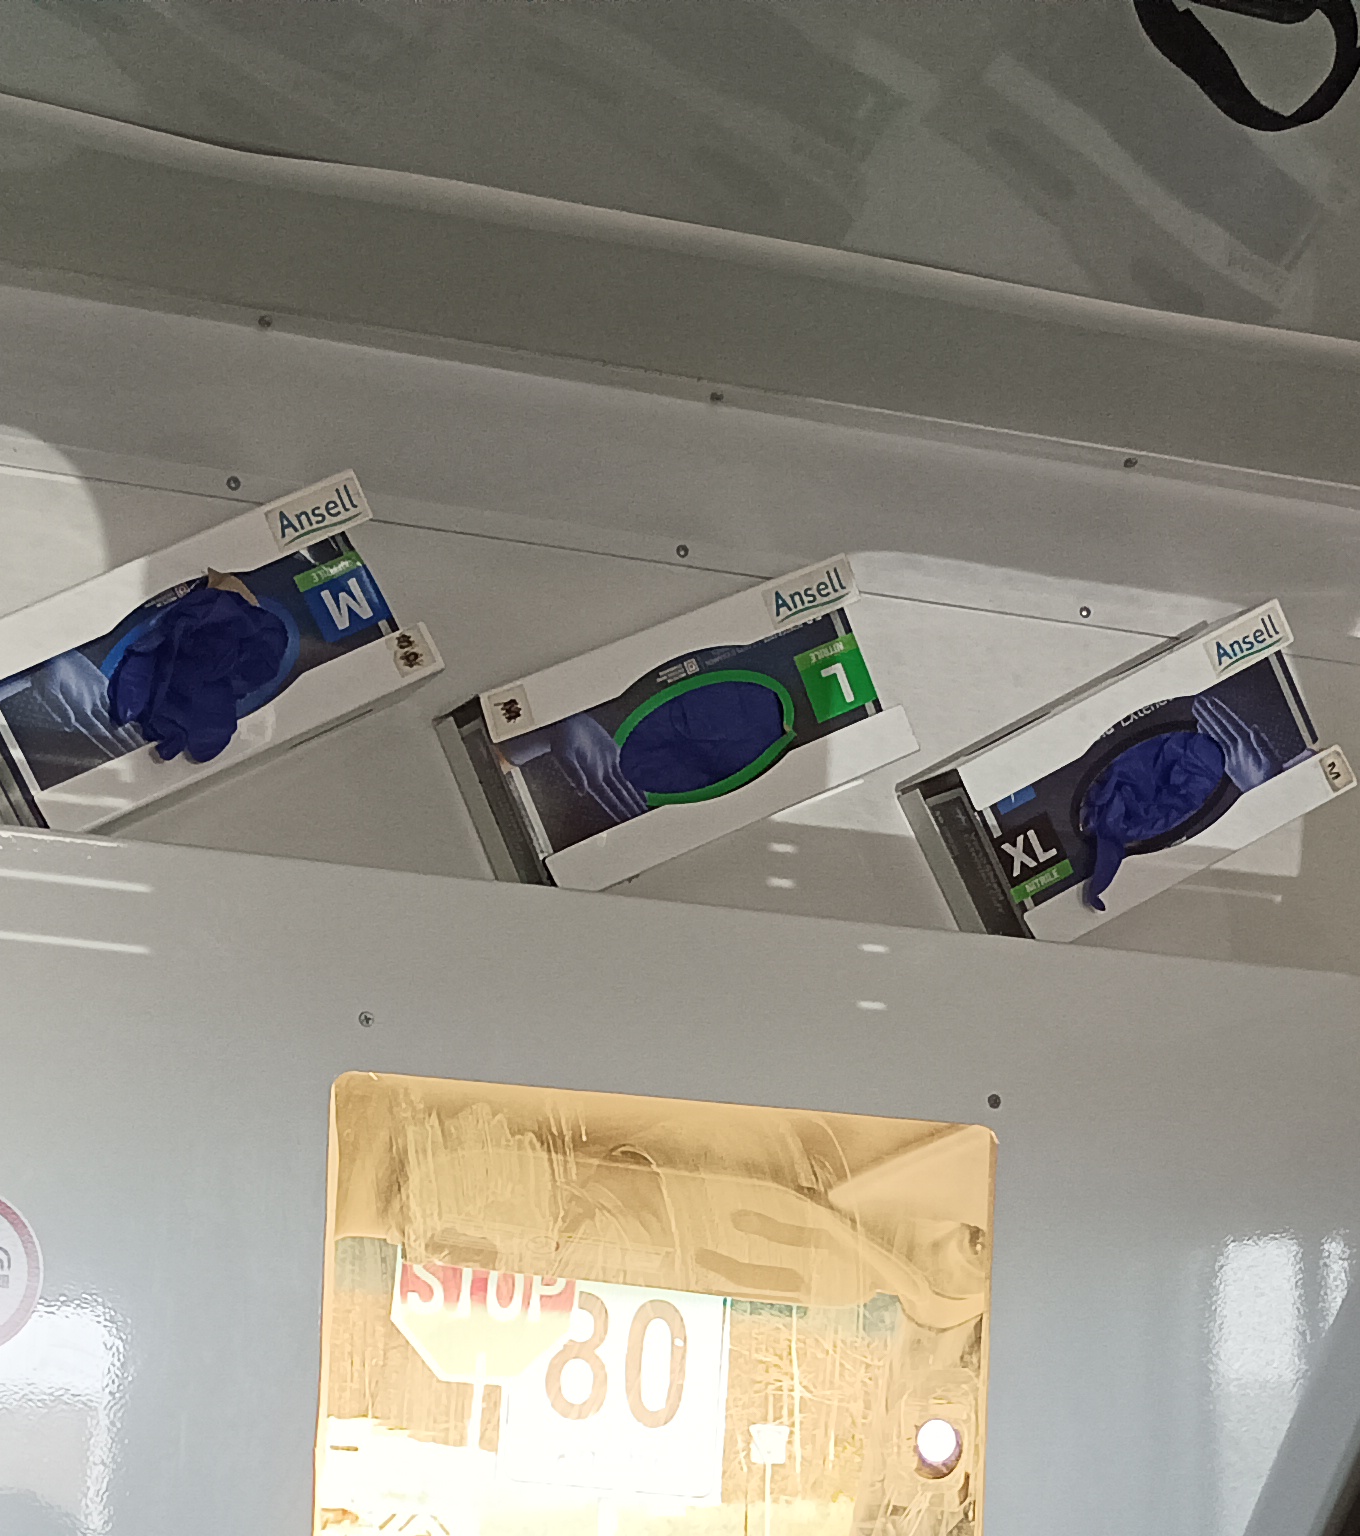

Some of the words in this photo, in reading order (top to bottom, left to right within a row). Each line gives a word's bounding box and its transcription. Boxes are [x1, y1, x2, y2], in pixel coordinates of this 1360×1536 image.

[277, 483, 358, 537] Ansell
[320, 577, 374, 631] M
[773, 566, 847, 618] Ansell
[808, 641, 845, 663] NITRILE
[1215, 614, 1280, 666] Ansell
[820, 661, 855, 703] L
[1000, 829, 1058, 878] XL
[1024, 868, 1060, 893] NITRILE
[406, 1262, 570, 1320] STOP
[545, 1289, 689, 1430] 80
